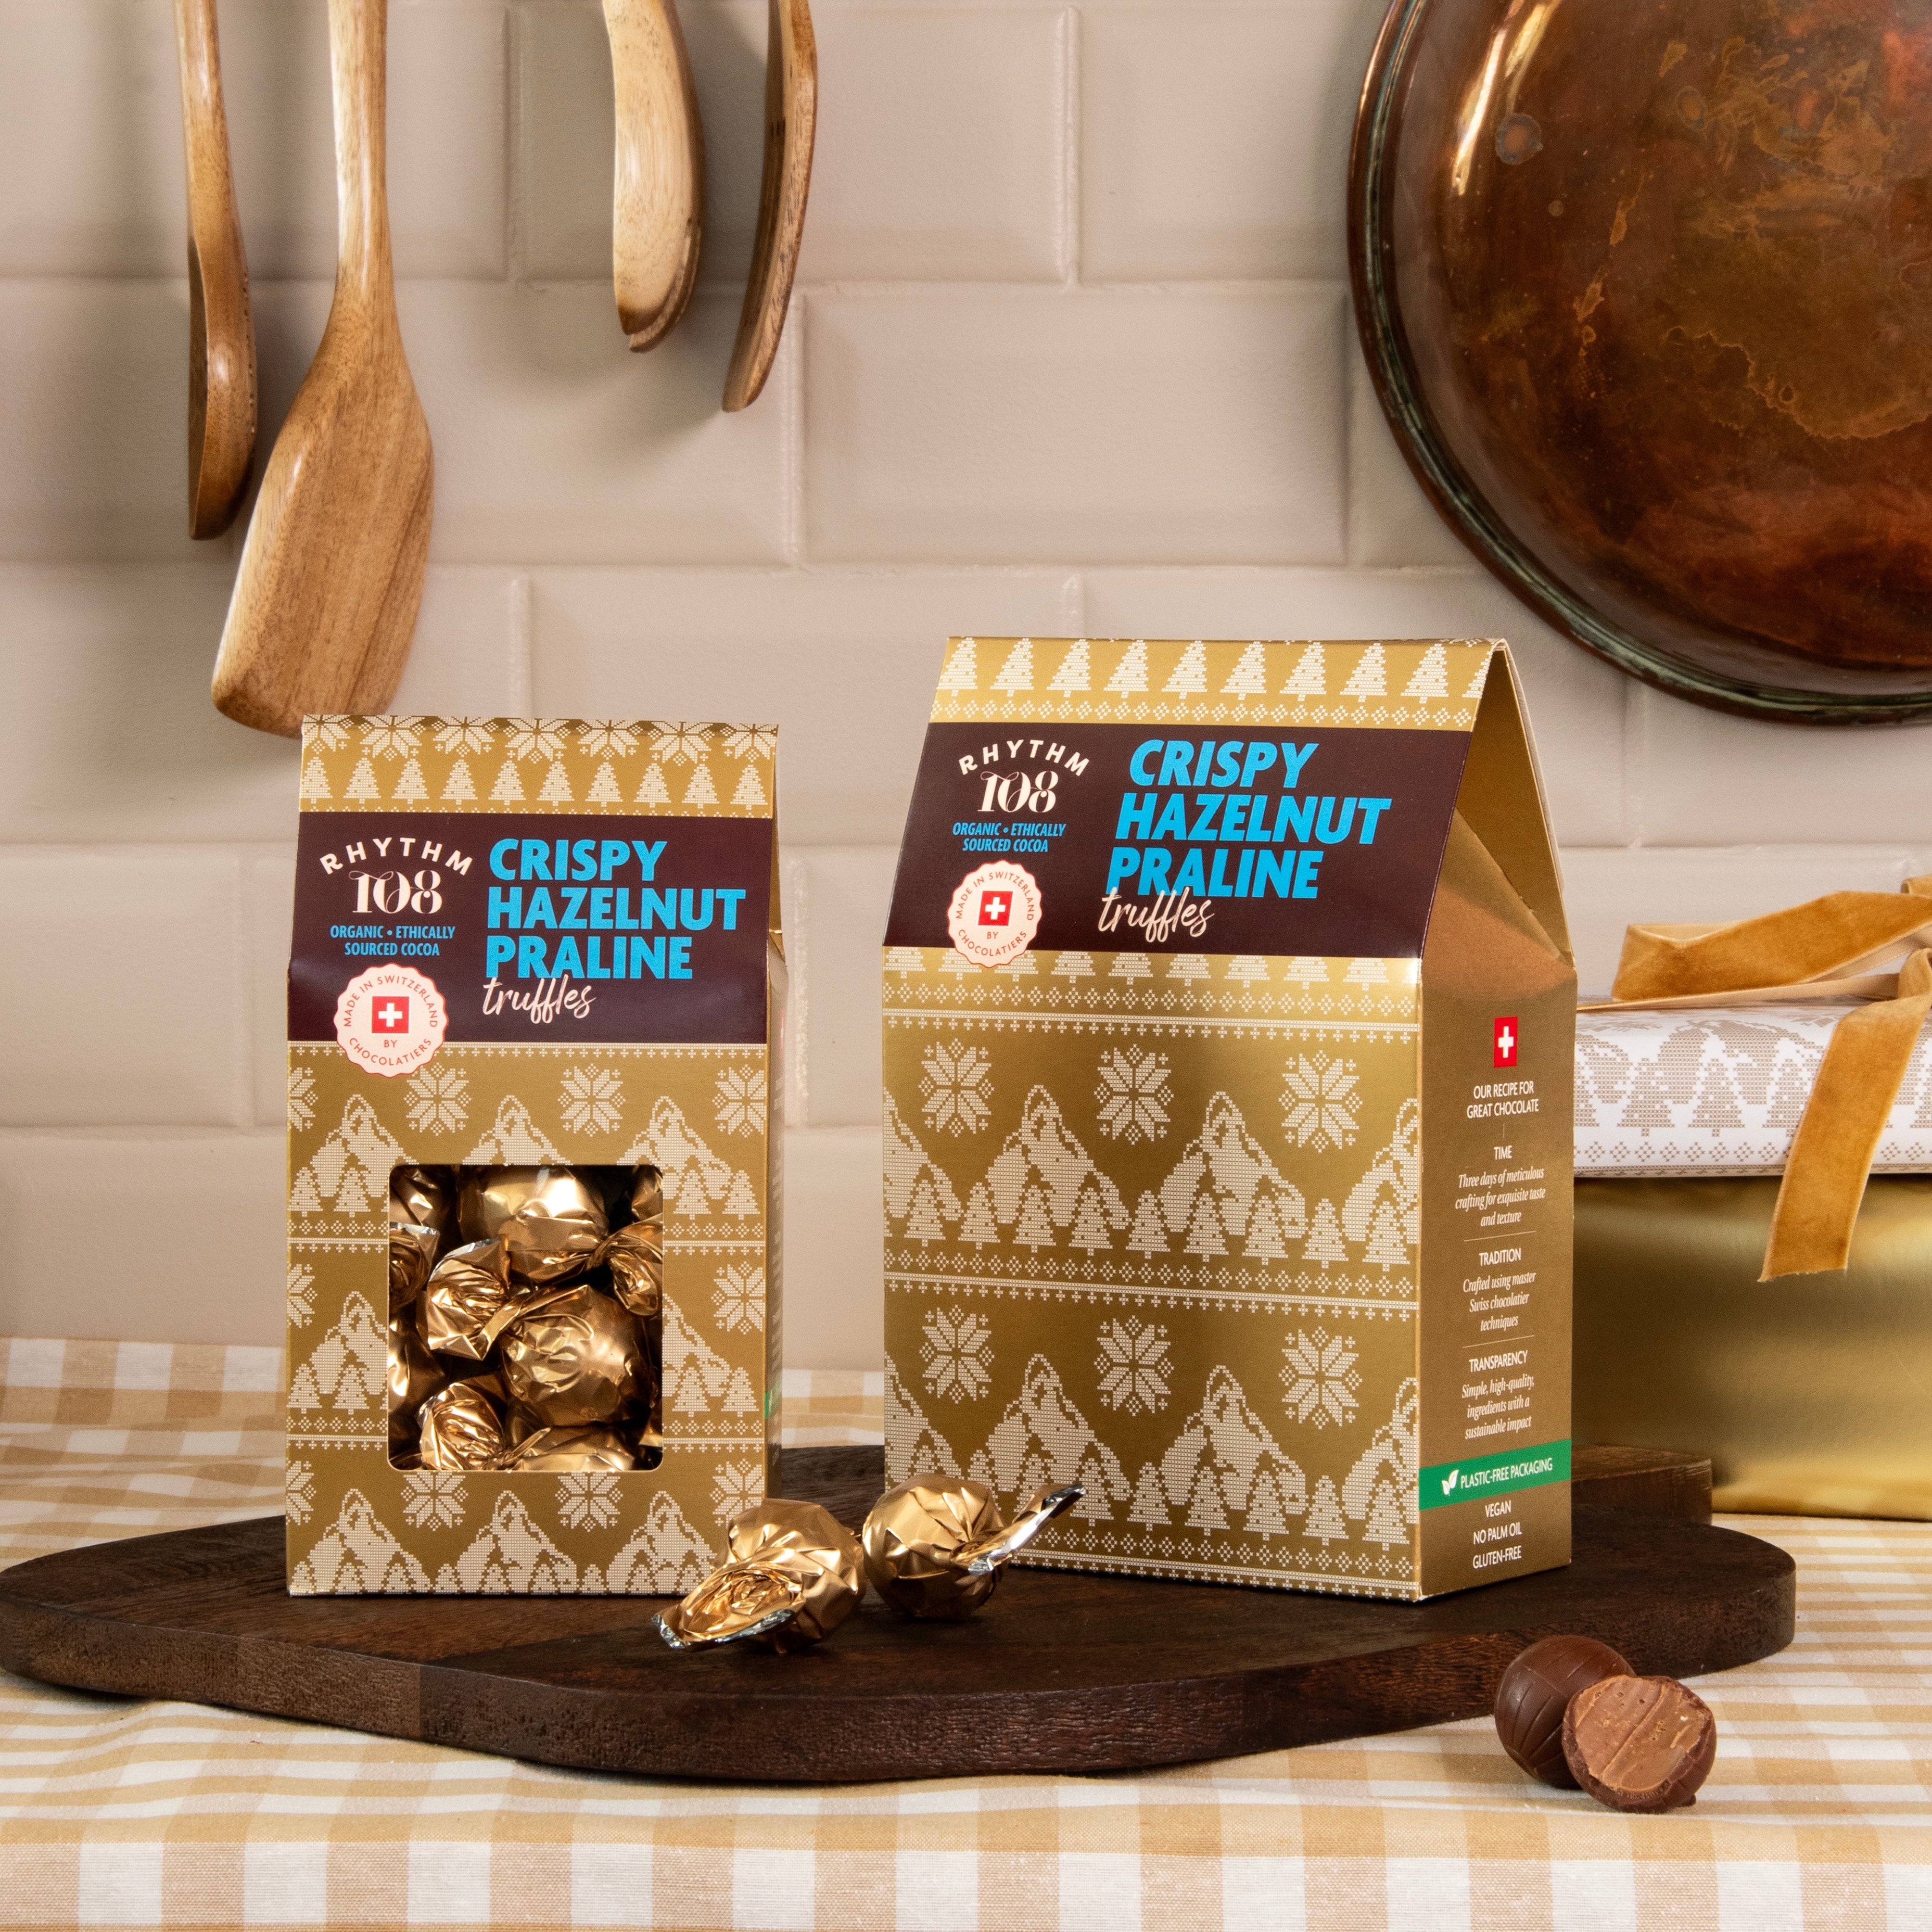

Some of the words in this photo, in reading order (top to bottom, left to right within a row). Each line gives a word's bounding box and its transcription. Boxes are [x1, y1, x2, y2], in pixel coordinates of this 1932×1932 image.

[958, 739, 1090, 778] RHYTHM
[1129, 740, 1319, 787] CRISPY
[977, 770, 1059, 814] 108
[952, 822, 1002, 837] ORGANIC
[1011, 822, 1066, 837] ETHICALLY
[1115, 793, 1392, 845] HAZELNUT
[320, 837, 473, 875] RHYTHM
[962, 838, 1011, 851] SOURCED
[1012, 838, 1049, 853] COCOA
[489, 838, 667, 881] CRISPY
[1105, 846, 1324, 899] PRALINE
[349, 870, 443, 914] 108
[956, 887, 973, 919] MADE
[973, 876, 985, 887] IN
[988, 871, 1035, 921] SWITZERLAND
[487, 887, 745, 931] HAZELNUT
[1098, 886, 1214, 943] truffles
[330, 925, 384, 939] ORGANIC
[395, 925, 455, 939] ETHICALLY
[958, 929, 1027, 957] CHOCOLATIERS
[345, 942, 398, 956] SOURCED
[401, 942, 440, 956] COCOA
[486, 935, 692, 980] PRALINE
[344, 993, 360, 1027] MADE
[360, 981, 373, 993] IN
[377, 975, 438, 1027] SWITZERLAND
[482, 974, 596, 1024] truffles
[349, 1037, 431, 1066] CHOCOLATIERS
[384, 1039, 398, 1048] BY
[1473, 1085, 1492, 1099] OUR
[1493, 1082, 1518, 1097] RECIPE
[1519, 1081, 1534, 1095] FOR
[1467, 1103, 1493, 1118] GREAT
[1494, 1099, 1539, 1116] CHOCOLATE
[1494, 1145, 1512, 1160] TIME
[1458, 1174, 1479, 1188] Three
[1480, 1172, 1497, 1188] days
[1498, 1168, 1507, 1187] of
[1506, 1166, 1545, 1183] meticulous
[1455, 1193, 1485, 1212] crafting
[1484, 1191, 1496, 1210] for
[1497, 1189, 1528, 1206] exquisite
[1529, 1187, 1546, 1200] taste
[1481, 1211, 1496, 1227] and
[1497, 1211, 1521, 1224] texture
[1479, 1248, 1521, 1266] TRADITION
[1463, 1275, 1491, 1295] Crafted
[1492, 1274, 1511, 1290] using
[1512, 1272, 1536, 1286] master
[1469, 1298, 1490, 1312] Swiss
[1490, 1291, 1530, 1309] chocolatier
[1480, 1315, 1519, 1331] techniques
[1469, 1350, 1528, 1372] TRANSPARENCY
[1461, 1381, 1489, 1400] Simple,
[1467, 1400, 1507, 1421] ingredients
[1508, 1394, 1524, 1410] with
[1524, 1397, 1530, 1407] a
[1465, 1418, 1506, 1440] sustainable
[1507, 1416, 1532, 1433] impact
[1460, 1466, 1509, 1489] PLASTIC-FREE
[1510, 1457, 1553, 1478] PACKAGING
[1485, 1499, 1511, 1518] VEGAN
[1473, 1529, 1486, 1545] NO
[1488, 1524, 1508, 1541] PALM
[1509, 1522, 1522, 1536] OIL
[1472, 1545, 1522, 1569] GLUTEN-FREE
